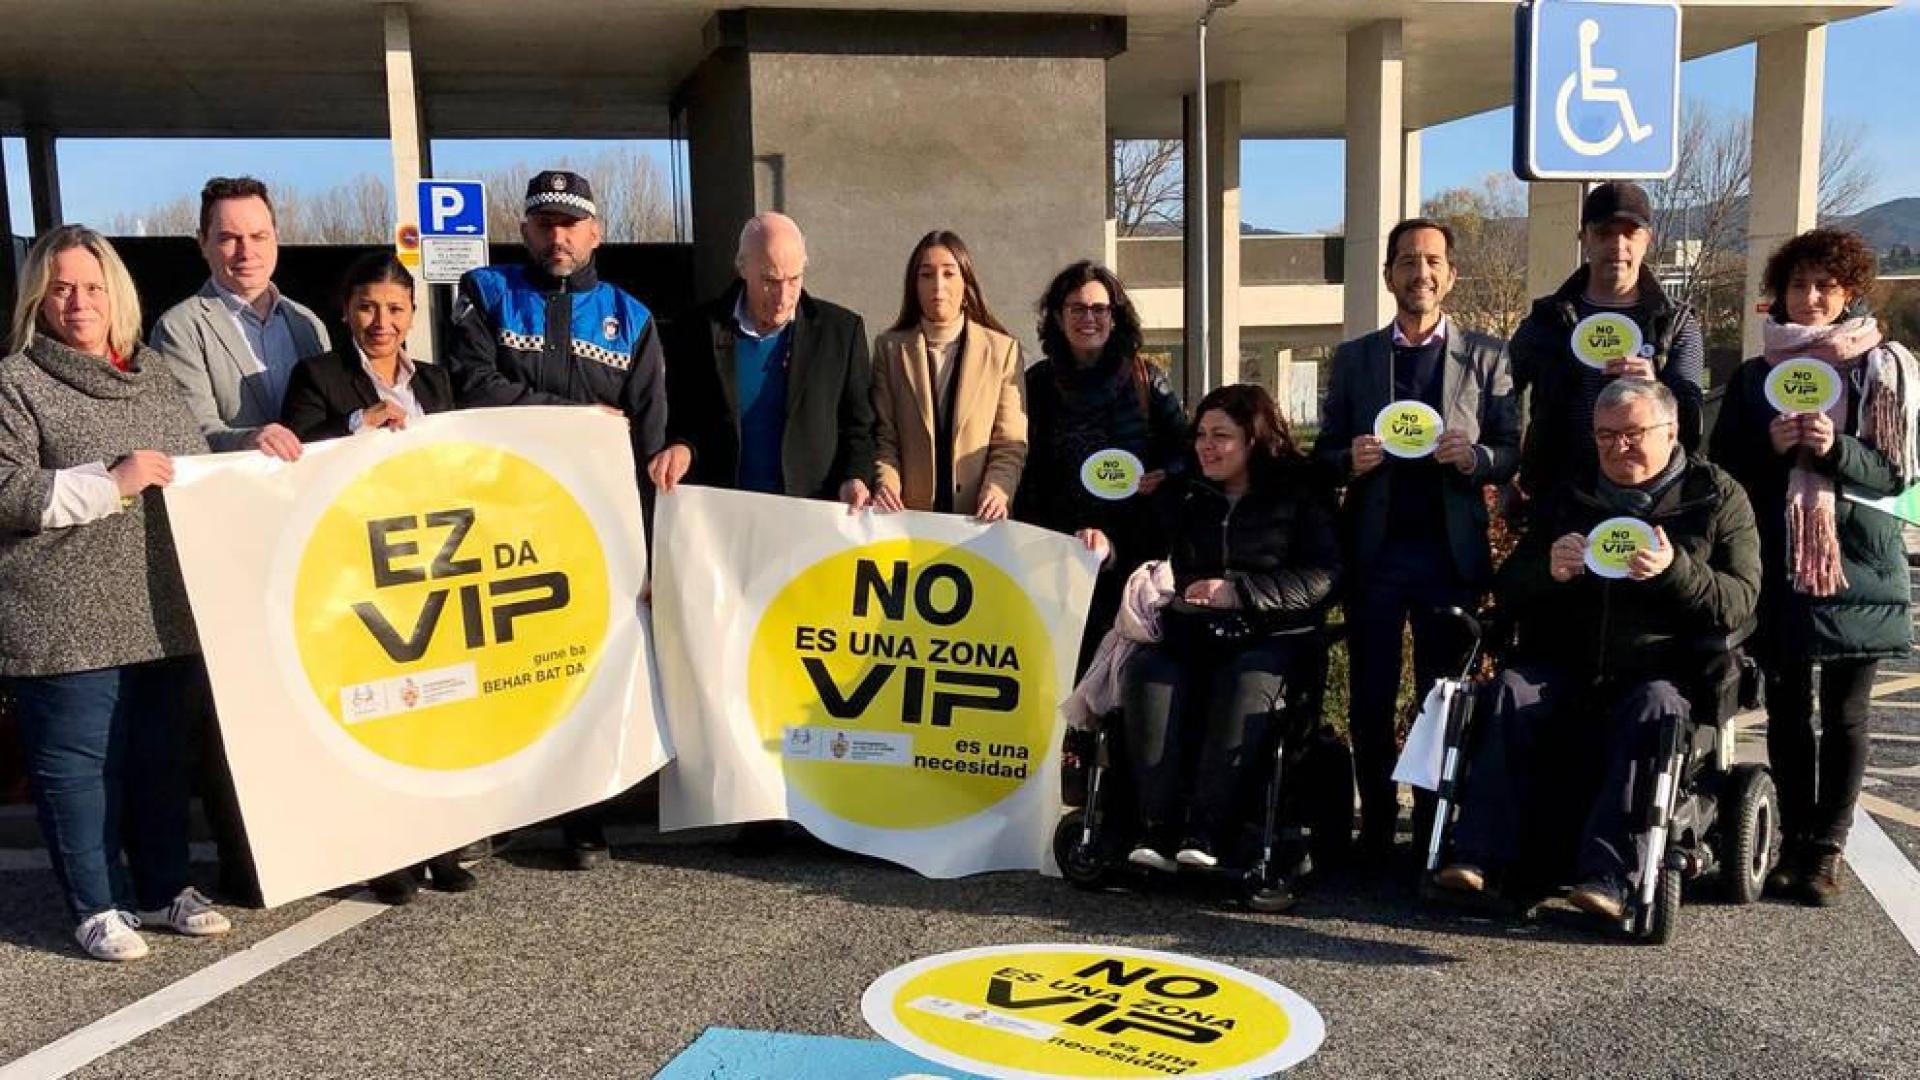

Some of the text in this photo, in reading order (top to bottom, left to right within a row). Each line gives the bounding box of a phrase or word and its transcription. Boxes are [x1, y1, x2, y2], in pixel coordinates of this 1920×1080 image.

[431, 186, 464, 231] P
[1588, 337, 1621, 348] VIP
[1596, 325, 1614, 334] NO
[1792, 371, 1812, 380] NO
[1784, 383, 1818, 395] VIP
[1392, 424, 1423, 436] VIP
[1401, 412, 1419, 423] NO
[1097, 470, 1126, 481] VIP
[1103, 461, 1120, 469] NO
[367, 507, 538, 588] EZ DA
[1611, 530, 1630, 539] NO
[1602, 543, 1636, 553] VIP
[853, 559, 973, 627] NO
[350, 571, 571, 664] VIP
[533, 645, 587, 666] gune ba
[795, 626, 1020, 671] ES UNA ZONA
[482, 671, 533, 695] BEHAR
[535, 666, 562, 684] BAT
[565, 662, 586, 677] DA
[801, 656, 1020, 728] VIP
[955, 740, 1029, 761] es una
[914, 754, 1028, 780] necesidad
[1074, 958, 1220, 1000] NO
[985, 977, 1223, 1045] VIP
[994, 966, 1237, 1031] ES UNA ZONA
[1047, 1036, 1187, 1076] necesidad
[1109, 1039, 1200, 1068] es una
